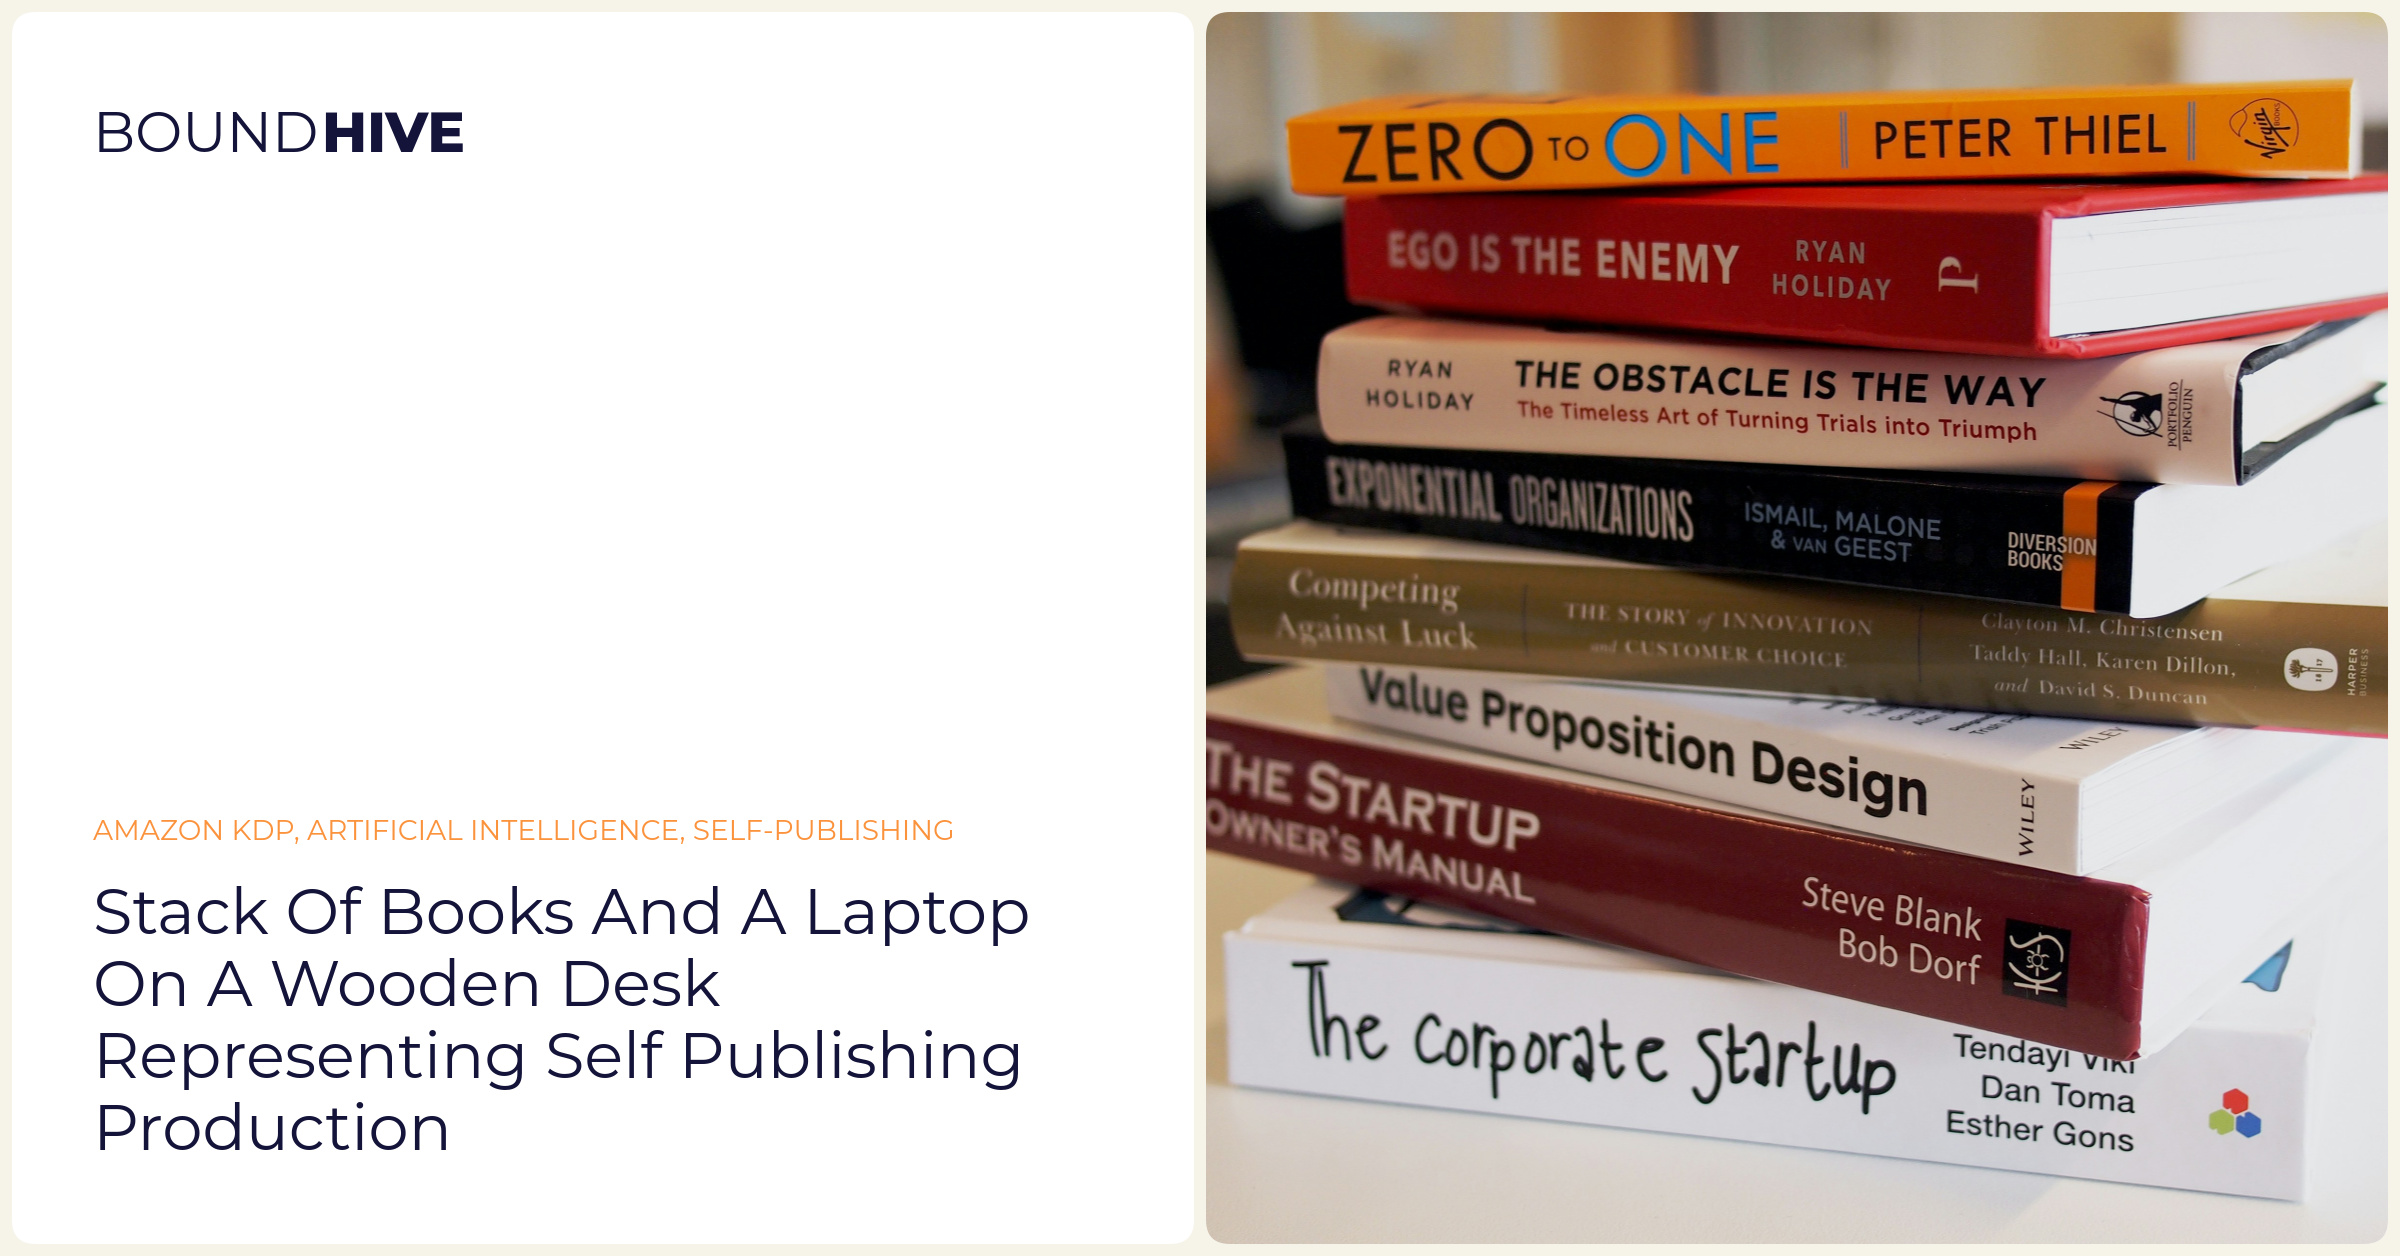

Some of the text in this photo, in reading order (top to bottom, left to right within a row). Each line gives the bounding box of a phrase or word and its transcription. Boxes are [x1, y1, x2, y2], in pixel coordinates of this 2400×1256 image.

[2244, 107, 2291, 159] Virgin
[2273, 103, 2281, 126] BOOKS
[1338, 112, 1779, 183] ZERO TO ONE
[1875, 113, 2166, 160] PETER THIEL
[1387, 230, 1739, 285] EGO IS THE ENEMY
[1796, 240, 1865, 264] RYAN
[1773, 274, 1891, 301] HOLIDAY
[1388, 359, 1453, 379] RYAN
[1515, 360, 2046, 408] THE OBSTACLE IS THE WAY
[1366, 389, 1474, 411] HOLIDAY
[1517, 400, 2037, 443] The Timeless Art of Turning Trials into Triumph
[2167, 382, 2179, 447] PORTFOLIO
[2183, 389, 2193, 442] PENGUIN
[1325, 455, 1695, 543] EXPONENTIAL ORGANIZATIONS
[1744, 502, 1941, 541] ISMAIL, MALONE
[1770, 529, 1912, 563] & VAN GEEST
[2008, 531, 2097, 556] DIVERSION
[2008, 550, 2064, 572] BOOKS
[1288, 568, 1461, 615] Competing
[1275, 611, 1478, 649] Against Luck
[1564, 602, 1874, 636] THE STORY of INNOVATION
[1982, 612, 2223, 642] Clayton M. Christensen
[1590, 639, 1848, 669] and CUSTOMER CHOICE
[1969, 644, 2236, 678] Taddy Hall, Karen Dillon,
[2347, 648, 2358, 696] HARPER
[2359, 648, 2369, 697] BUSINESS
[1994, 678, 2208, 705] and David S. Duncan
[1359, 668, 1928, 818] Value Proposition Design
[2058, 726, 2129, 750] WILEY
[1206, 738, 1541, 852] THE STARTUP
[2018, 778, 2035, 857] WILEY
[1206, 797, 1537, 905] OWNER'S MANUAL
[1802, 876, 1982, 941] Steve Blank
[1839, 928, 1982, 985] Bob Dorf
[1291, 959, 1388, 1061] The
[1953, 1033, 2070, 1073] Tendayi
[1982, 1074, 2136, 1114] Dan Toma
[1947, 1109, 2134, 1152] Esther Gons
